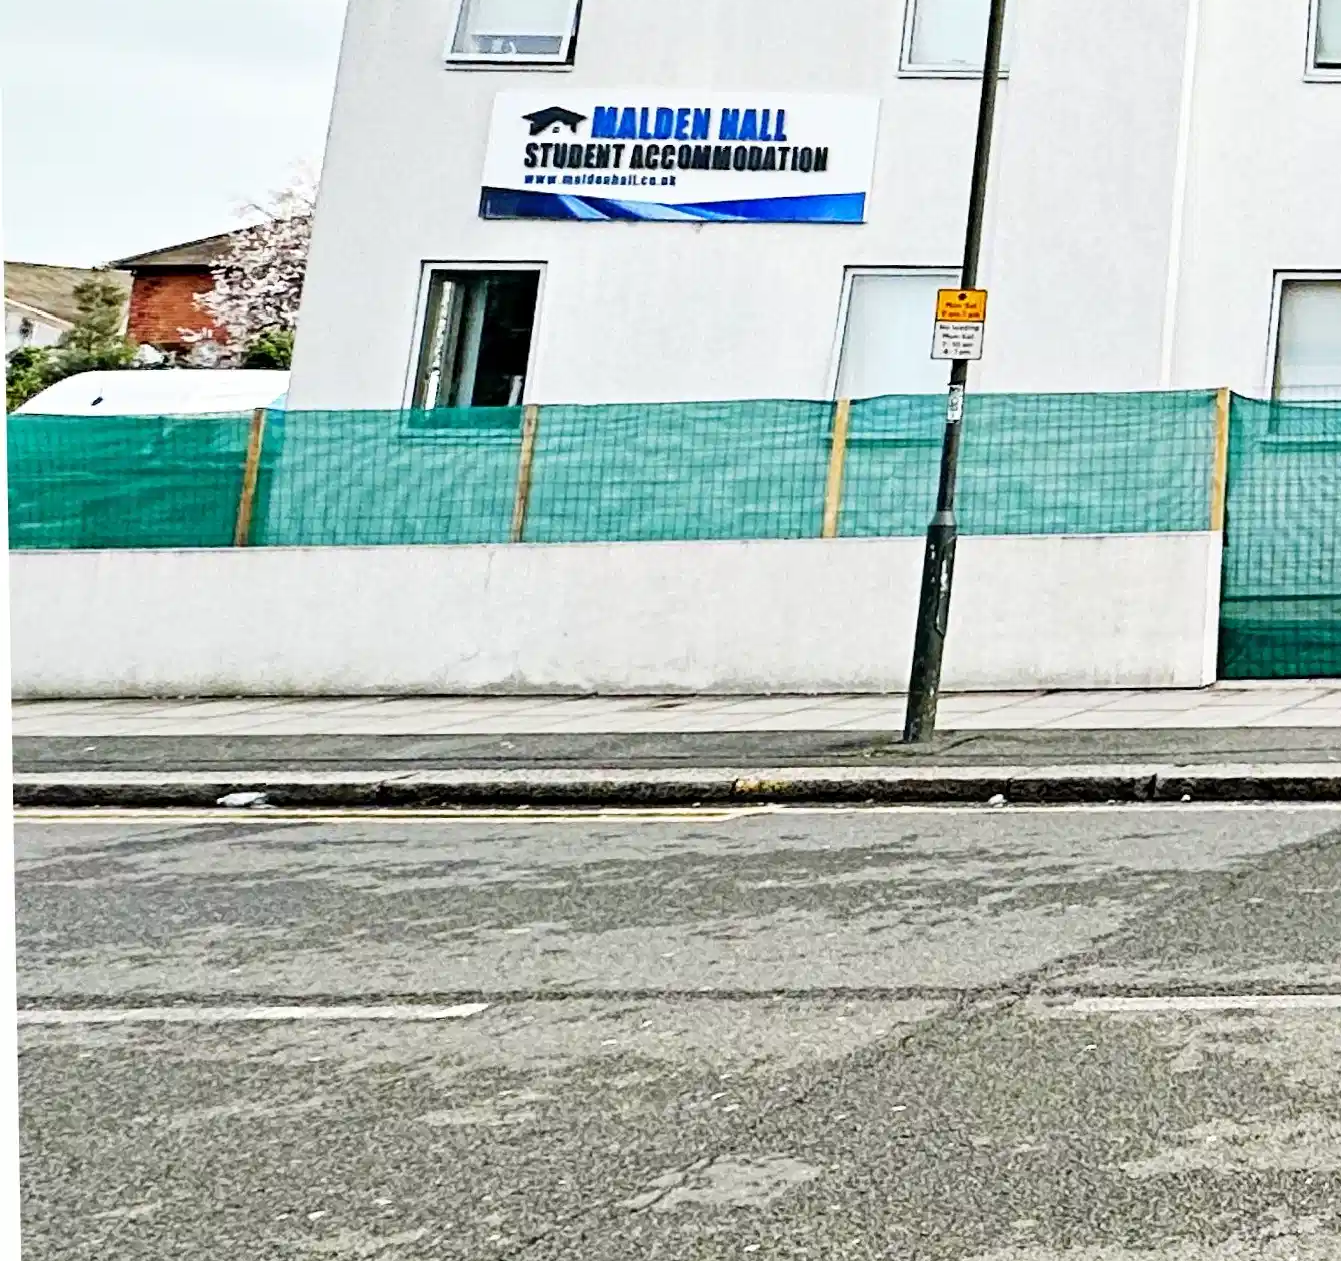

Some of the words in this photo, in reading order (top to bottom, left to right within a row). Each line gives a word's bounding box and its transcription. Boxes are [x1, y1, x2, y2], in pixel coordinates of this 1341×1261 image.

[591, 106, 711, 140] MALDEN
[718, 108, 787, 141] HALL
[524, 142, 626, 169] STUDENT
[629, 144, 829, 172] ACCOMMODATION
[524, 173, 677, 186] www.maldenhall.co.uk
